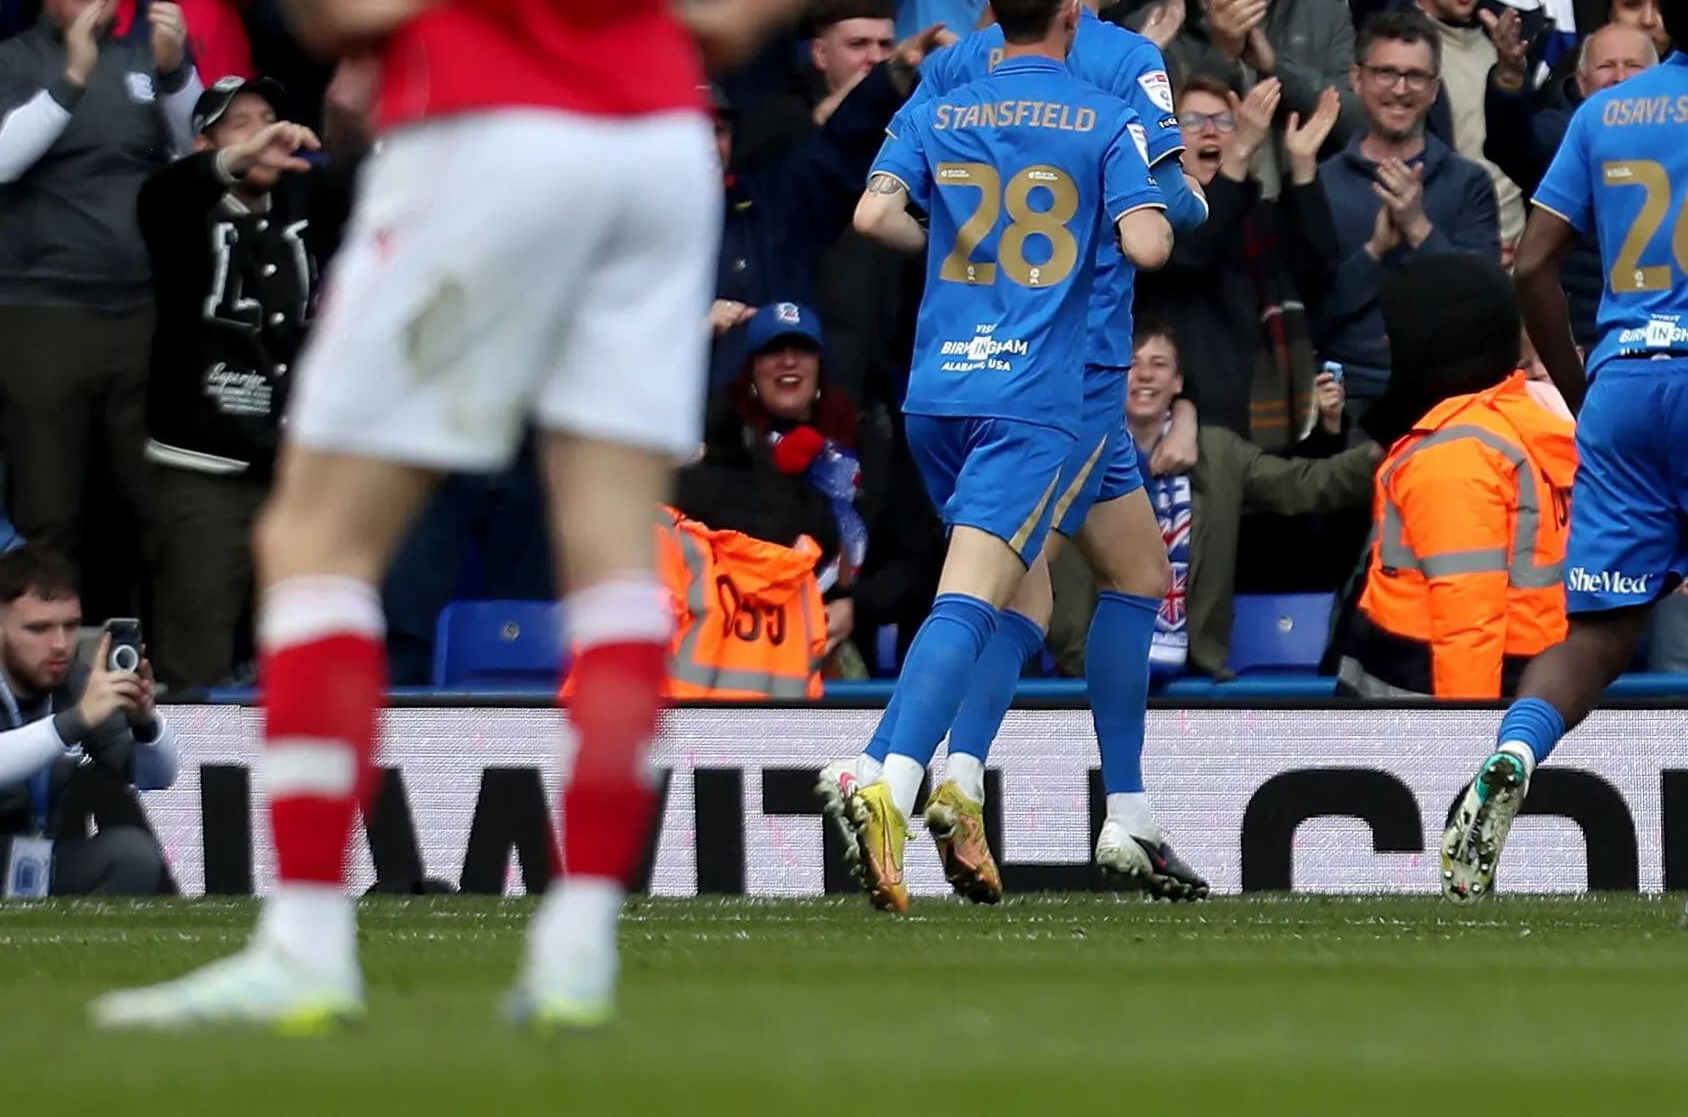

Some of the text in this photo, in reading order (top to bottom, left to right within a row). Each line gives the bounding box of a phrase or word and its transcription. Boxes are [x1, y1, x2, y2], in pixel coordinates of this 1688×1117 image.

[934, 100, 1097, 132] STANSFIELD
[936, 162, 1078, 288] 28
[1567, 567, 1647, 594] SheMed
